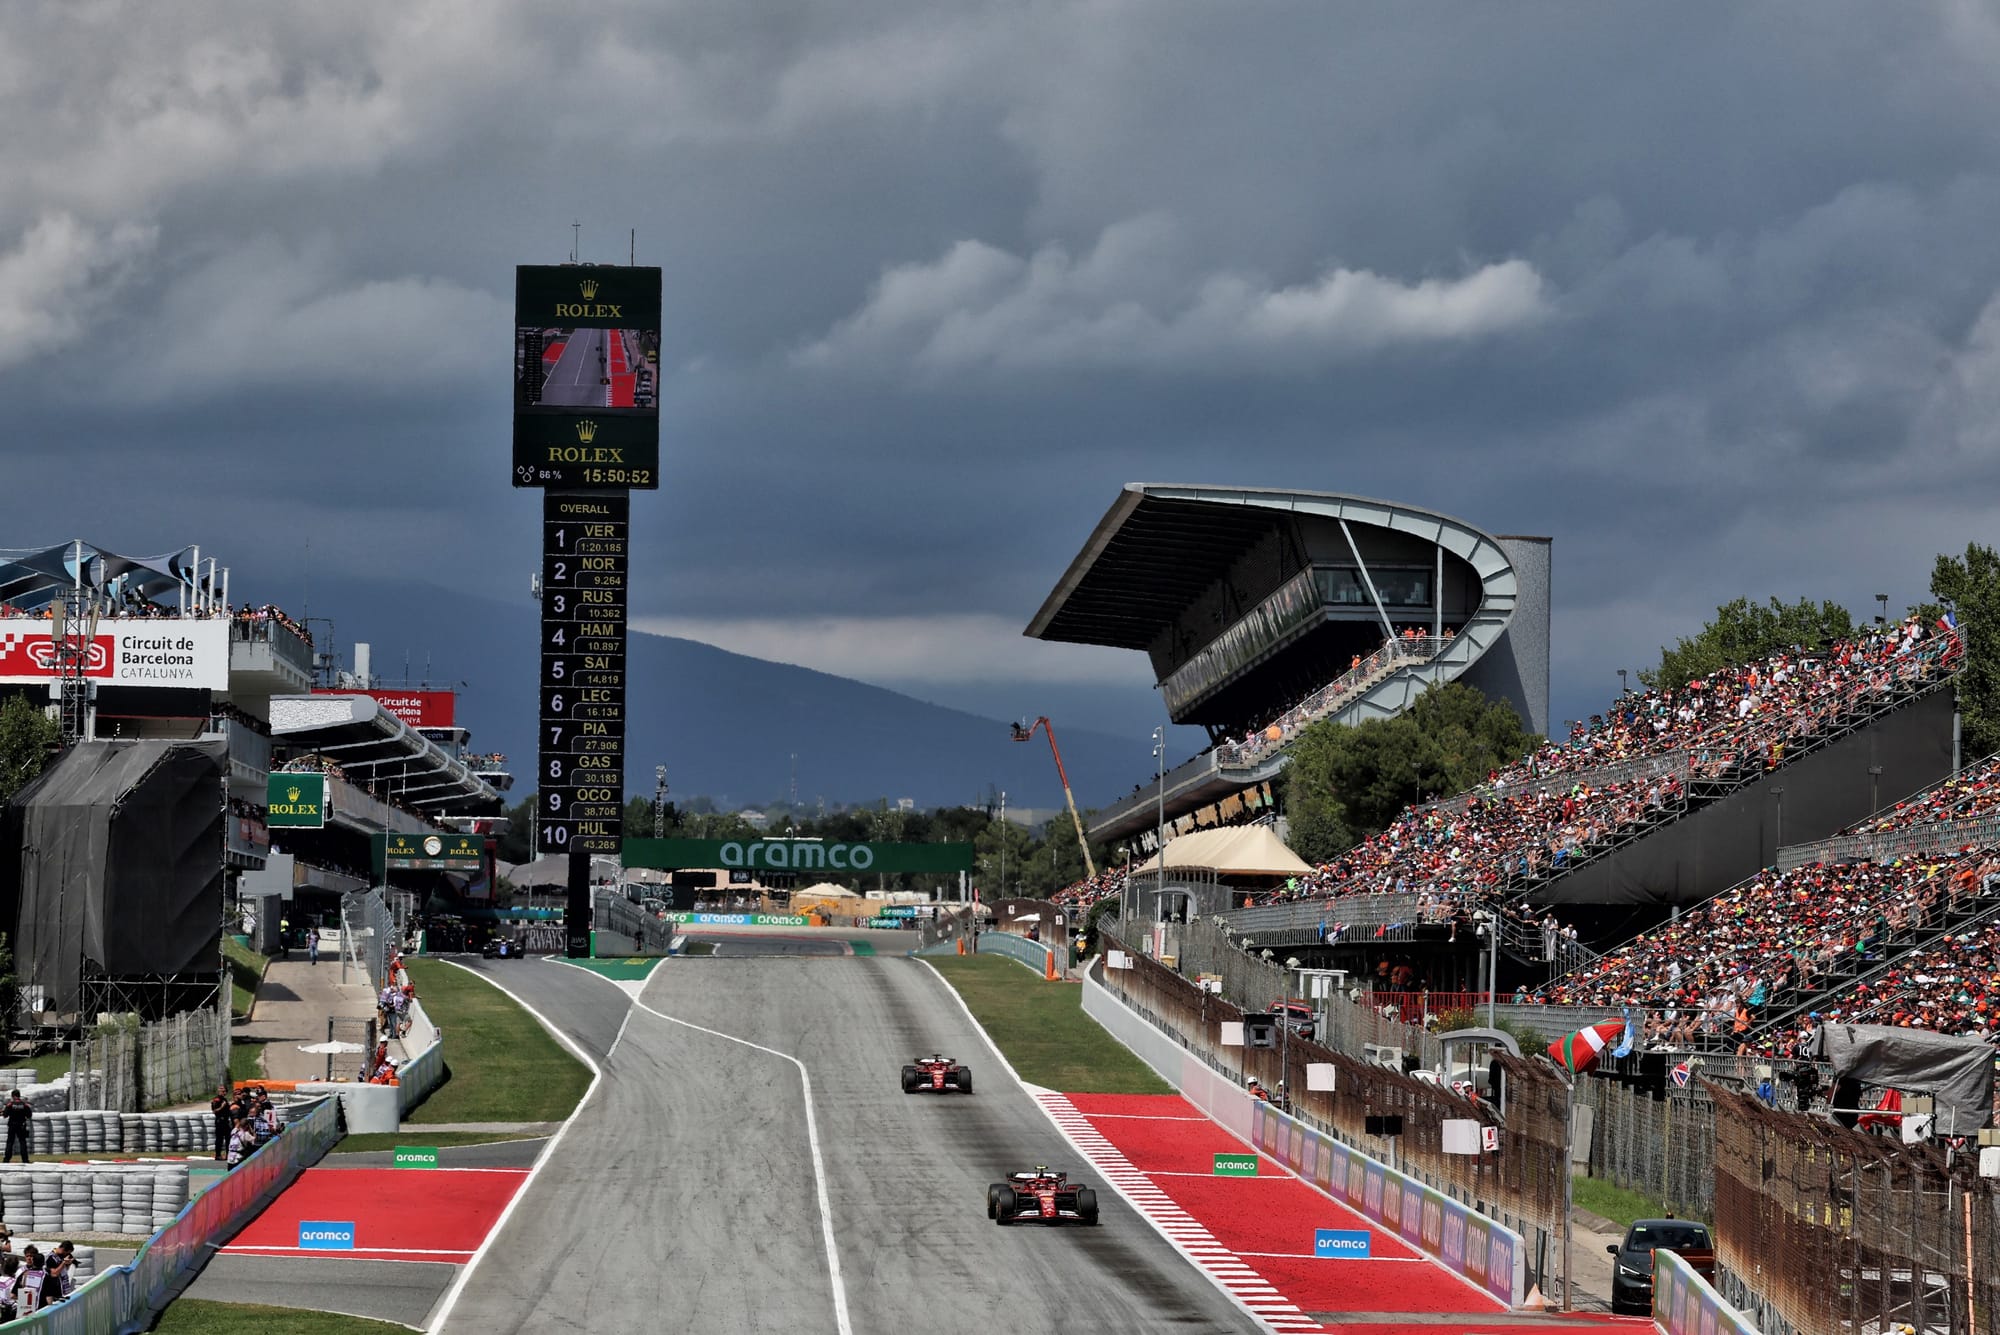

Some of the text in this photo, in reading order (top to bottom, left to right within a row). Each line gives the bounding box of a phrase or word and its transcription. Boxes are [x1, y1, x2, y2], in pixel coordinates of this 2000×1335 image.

[556, 304, 622, 318] ROLEX
[548, 448, 624, 463] ROLEX
[584, 470, 650, 484] 15:50:52
[560, 504, 610, 514] OVERALL
[555, 525, 614, 547] 1 VER
[581, 543, 621, 552] 1:20.185
[554, 558, 614, 580] 2 NOR
[594, 576, 621, 585] 9.264
[554, 591, 613, 612] 3 RUS
[552, 624, 614, 646] 4 HAM
[122, 636, 194, 650] Circuit de
[588, 642, 619, 651] 10.897
[122, 652, 193, 665] Barcelona
[121, 668, 193, 679] CATALUNYA
[552, 656, 609, 679] 5 SAI
[378, 698, 422, 706] Circuit de
[551, 690, 610, 712] 6 LEC
[389, 707, 422, 715] rcelona
[586, 708, 618, 717] 16.134
[551, 723, 607, 744] 7 PIA
[586, 741, 617, 750] 27.906
[550, 756, 610, 777] 8 GAS
[584, 774, 617, 783] 30.183
[550, 789, 611, 811] 9 OCO
[269, 804, 317, 814] ROLEX
[543, 822, 608, 844] 10 HUL
[720, 842, 873, 870] aramco
[700, 913, 744, 923] aramco
[758, 914, 803, 925] aramco
[526, 930, 563, 949] RWAYS
[1216, 1161, 1255, 1170] aramco
[302, 1231, 350, 1241] aramco
[1318, 1239, 1366, 1249] aramco
